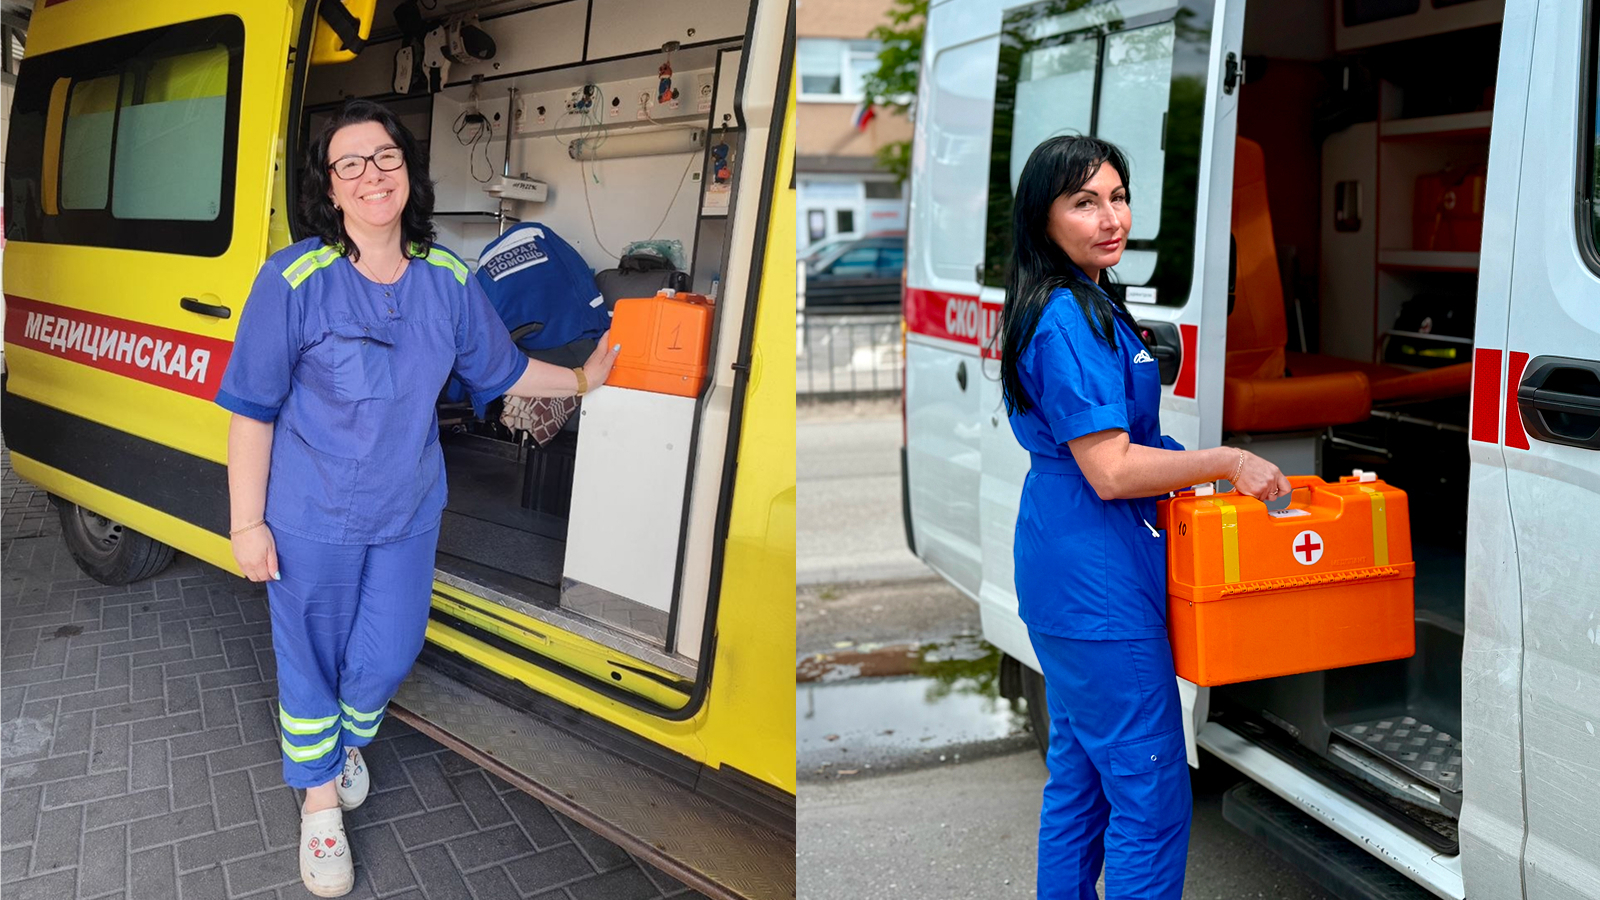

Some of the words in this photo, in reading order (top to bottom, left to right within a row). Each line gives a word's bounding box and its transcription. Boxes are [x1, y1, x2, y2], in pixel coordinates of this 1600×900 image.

[487, 242, 538, 268] СКОРАЯ
[489, 250, 543, 276] ПОМОЩЬ
[945, 298, 980, 339] СКО
[24, 312, 211, 384] МЕДИЦИНСКАЯ
[667, 321, 682, 350] 1
[1178, 520, 1187, 537] 10
